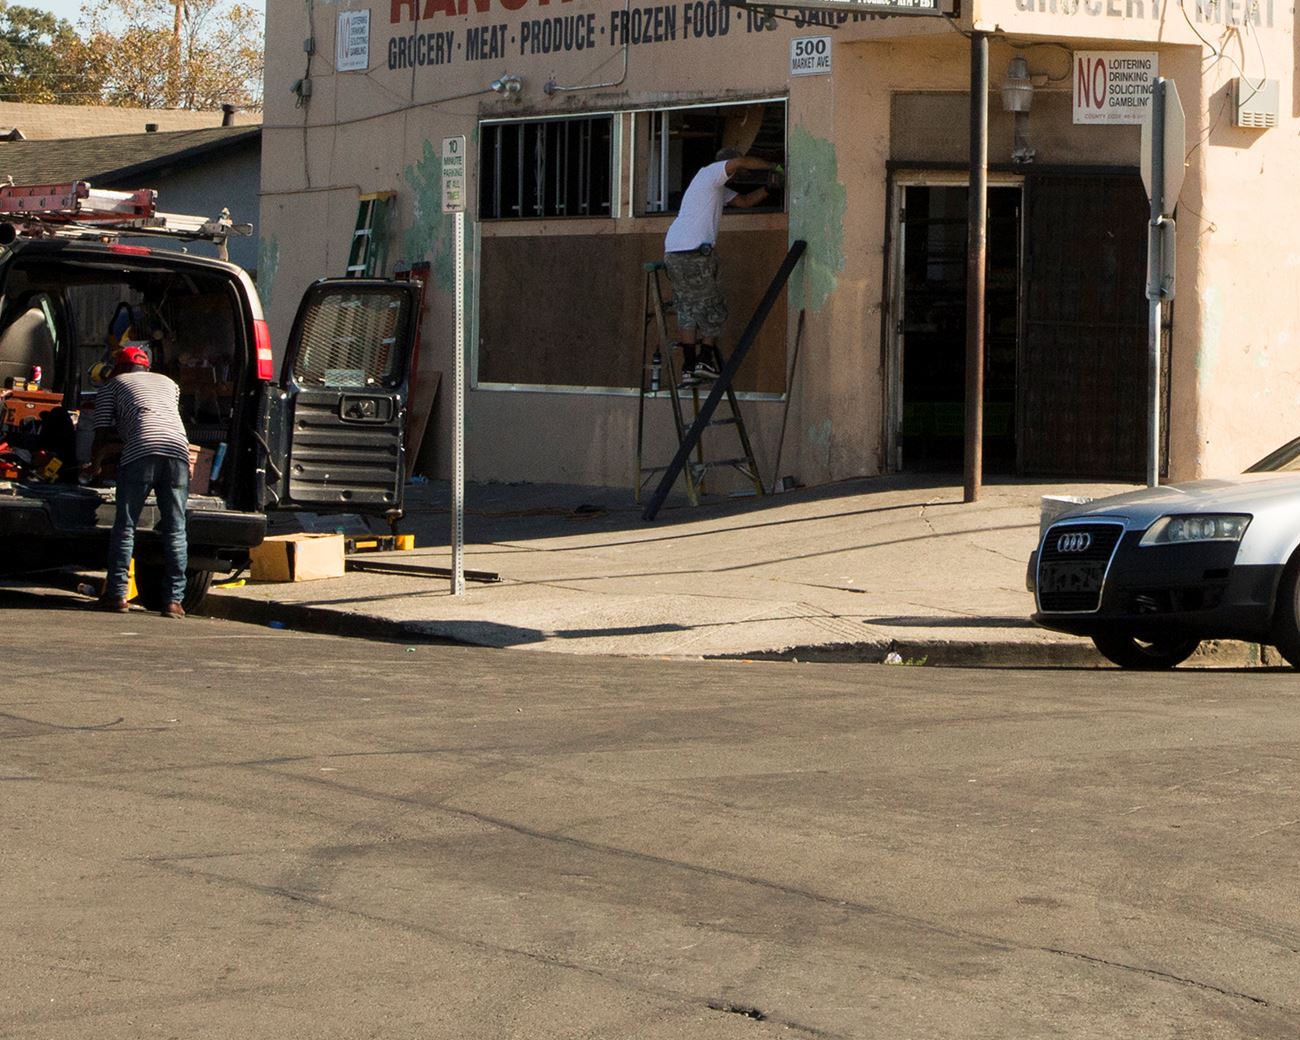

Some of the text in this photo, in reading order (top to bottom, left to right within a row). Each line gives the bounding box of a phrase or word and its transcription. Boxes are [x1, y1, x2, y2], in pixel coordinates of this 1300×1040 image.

[388, 31, 454, 71] GROCERY
[466, 24, 508, 61] MEAT
[520, 13, 596, 56] PRODUCE
[610, 5, 677, 46] FROZEN
[683, 0, 730, 39] FOOD
[795, 39, 826, 57] 500
[792, 58, 815, 70] MARKET
[1109, 59, 1151, 70] LOITERING
[1078, 57, 1107, 110] NO
[1109, 72, 1148, 82] DRINKING
[449, 140, 458, 154] 10
